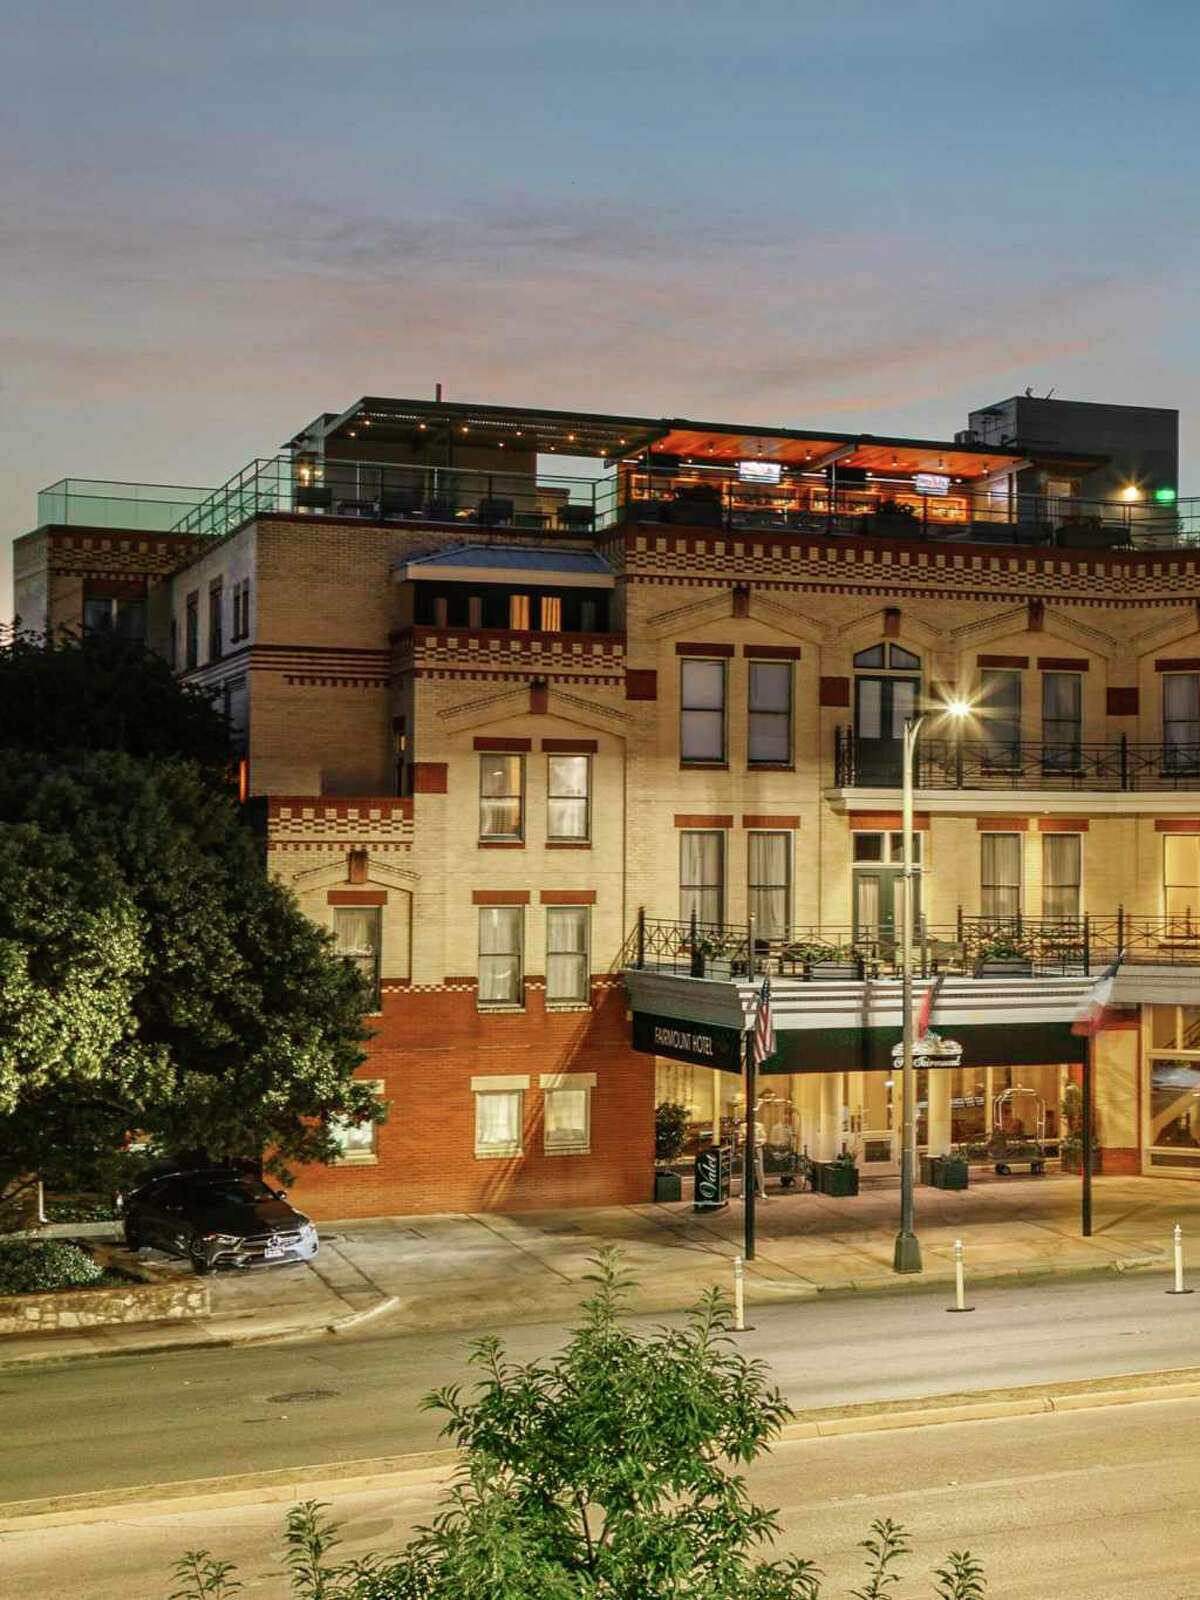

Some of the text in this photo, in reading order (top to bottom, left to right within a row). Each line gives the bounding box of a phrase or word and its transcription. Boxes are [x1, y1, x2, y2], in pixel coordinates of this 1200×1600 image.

[655, 1026, 714, 1057] FAIRMOUNT HOTEL
[698, 1154, 718, 1198] Valet
